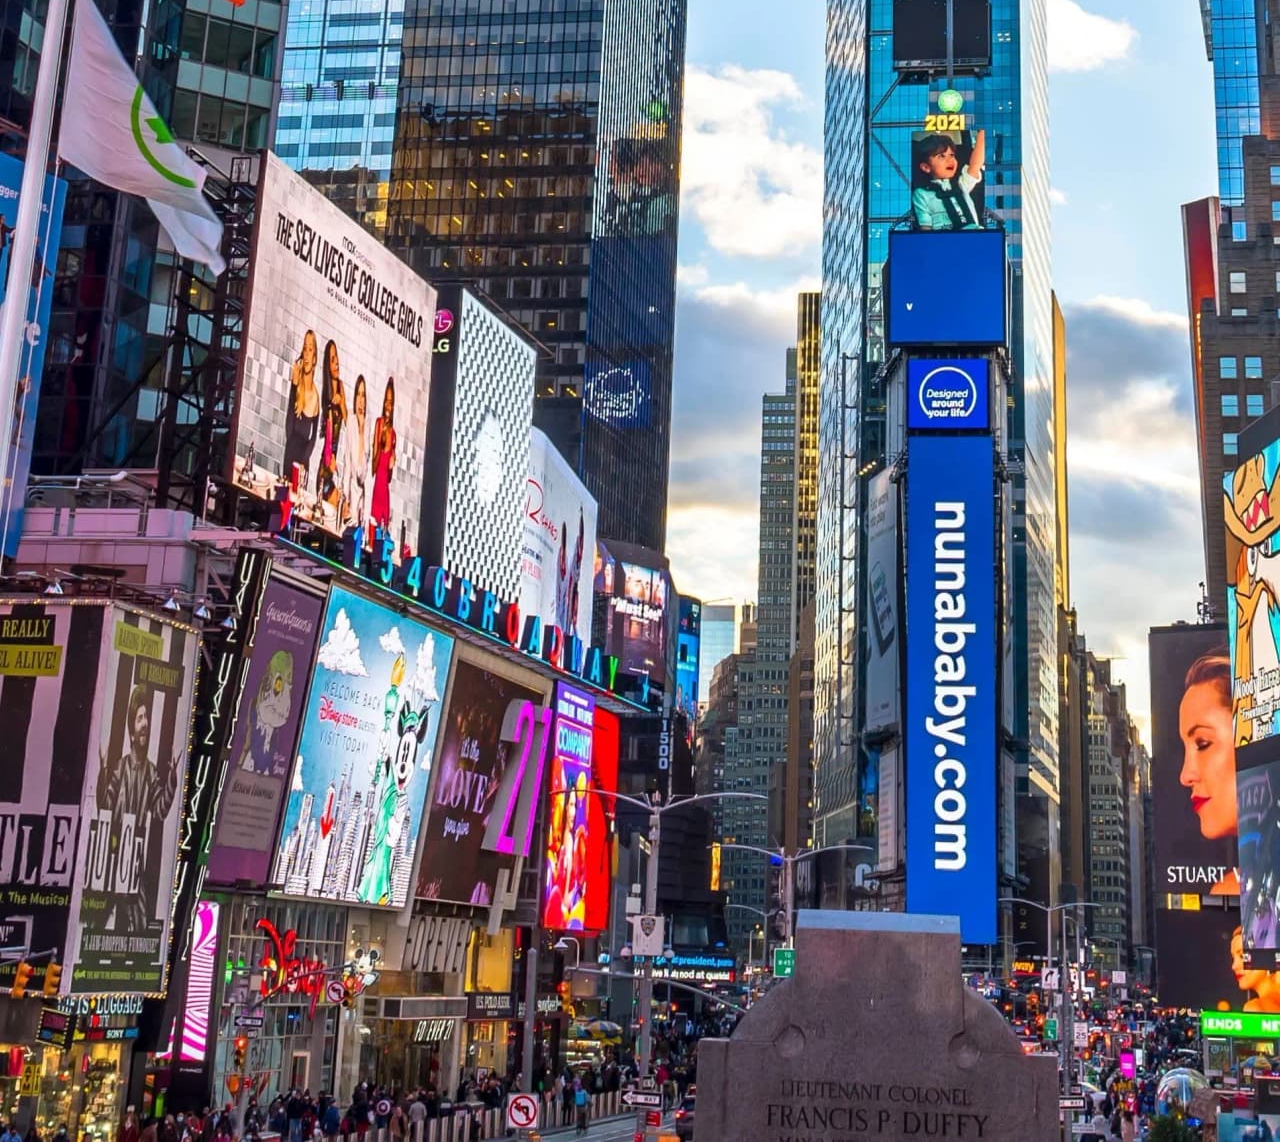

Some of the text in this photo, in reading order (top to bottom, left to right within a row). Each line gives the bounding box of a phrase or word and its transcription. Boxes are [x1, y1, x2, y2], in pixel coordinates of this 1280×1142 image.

[924, 114, 966, 131] 2021
[276, 212, 423, 348] THE SEX LIVES OF COLLEGE GIRLS
[926, 388, 968, 402] Designed
[932, 399, 964, 409] around
[928, 409, 951, 420] your
[2, 619, 50, 638] REALLY
[15, 650, 57, 669] ALIVE!
[323, 681, 361, 703] WELCOME
[925, 500, 977, 871] nunababy.com
[659, 719, 668, 769] 1500
[437, 767, 489, 814] LOVE
[1167, 866, 1226, 884] STUART
[8, 890, 27, 904] The
[781, 1079, 972, 1106] LIEUTENANT COLONEL
[767, 1104, 989, 1138] FRANCIS DUFFY
